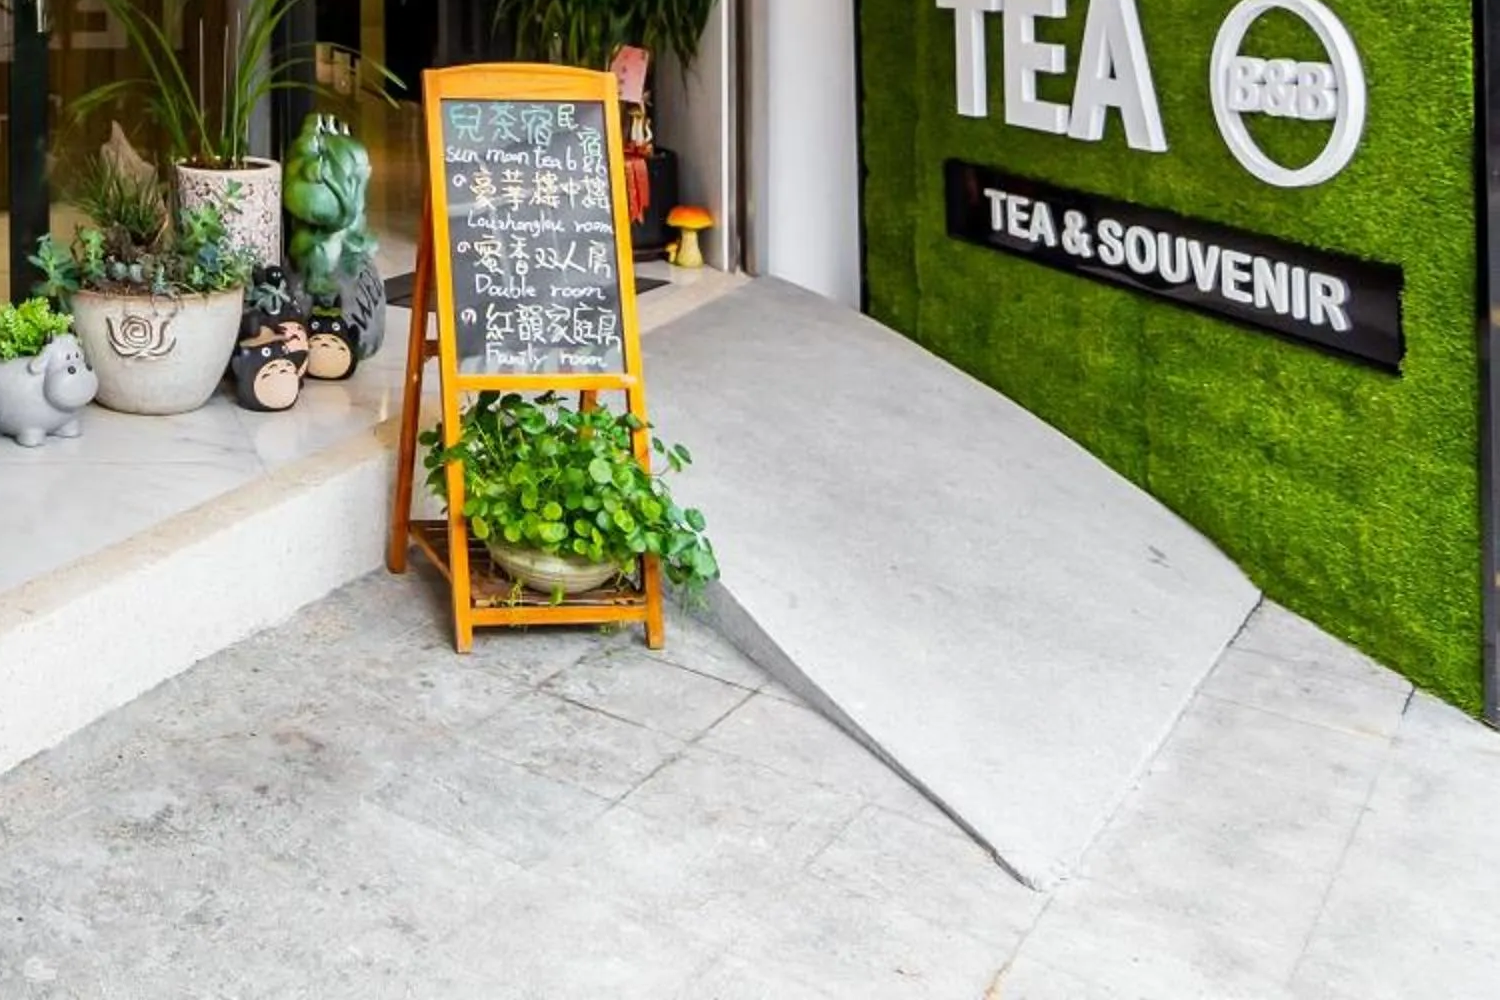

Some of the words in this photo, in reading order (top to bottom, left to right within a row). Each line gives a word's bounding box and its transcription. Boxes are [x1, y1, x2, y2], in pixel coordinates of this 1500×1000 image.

[1227, 57, 1337, 121] B&B
[533, 145, 563, 170] tea
[573, 219, 614, 234] room
[983, 188, 1056, 248] TEA
[1061, 209, 1093, 260] &
[1097, 217, 1351, 333] SOUVENIR
[475, 273, 537, 299] Double
[550, 284, 607, 300] room
[485, 342, 549, 372] Family
[560, 352, 609, 368] room
